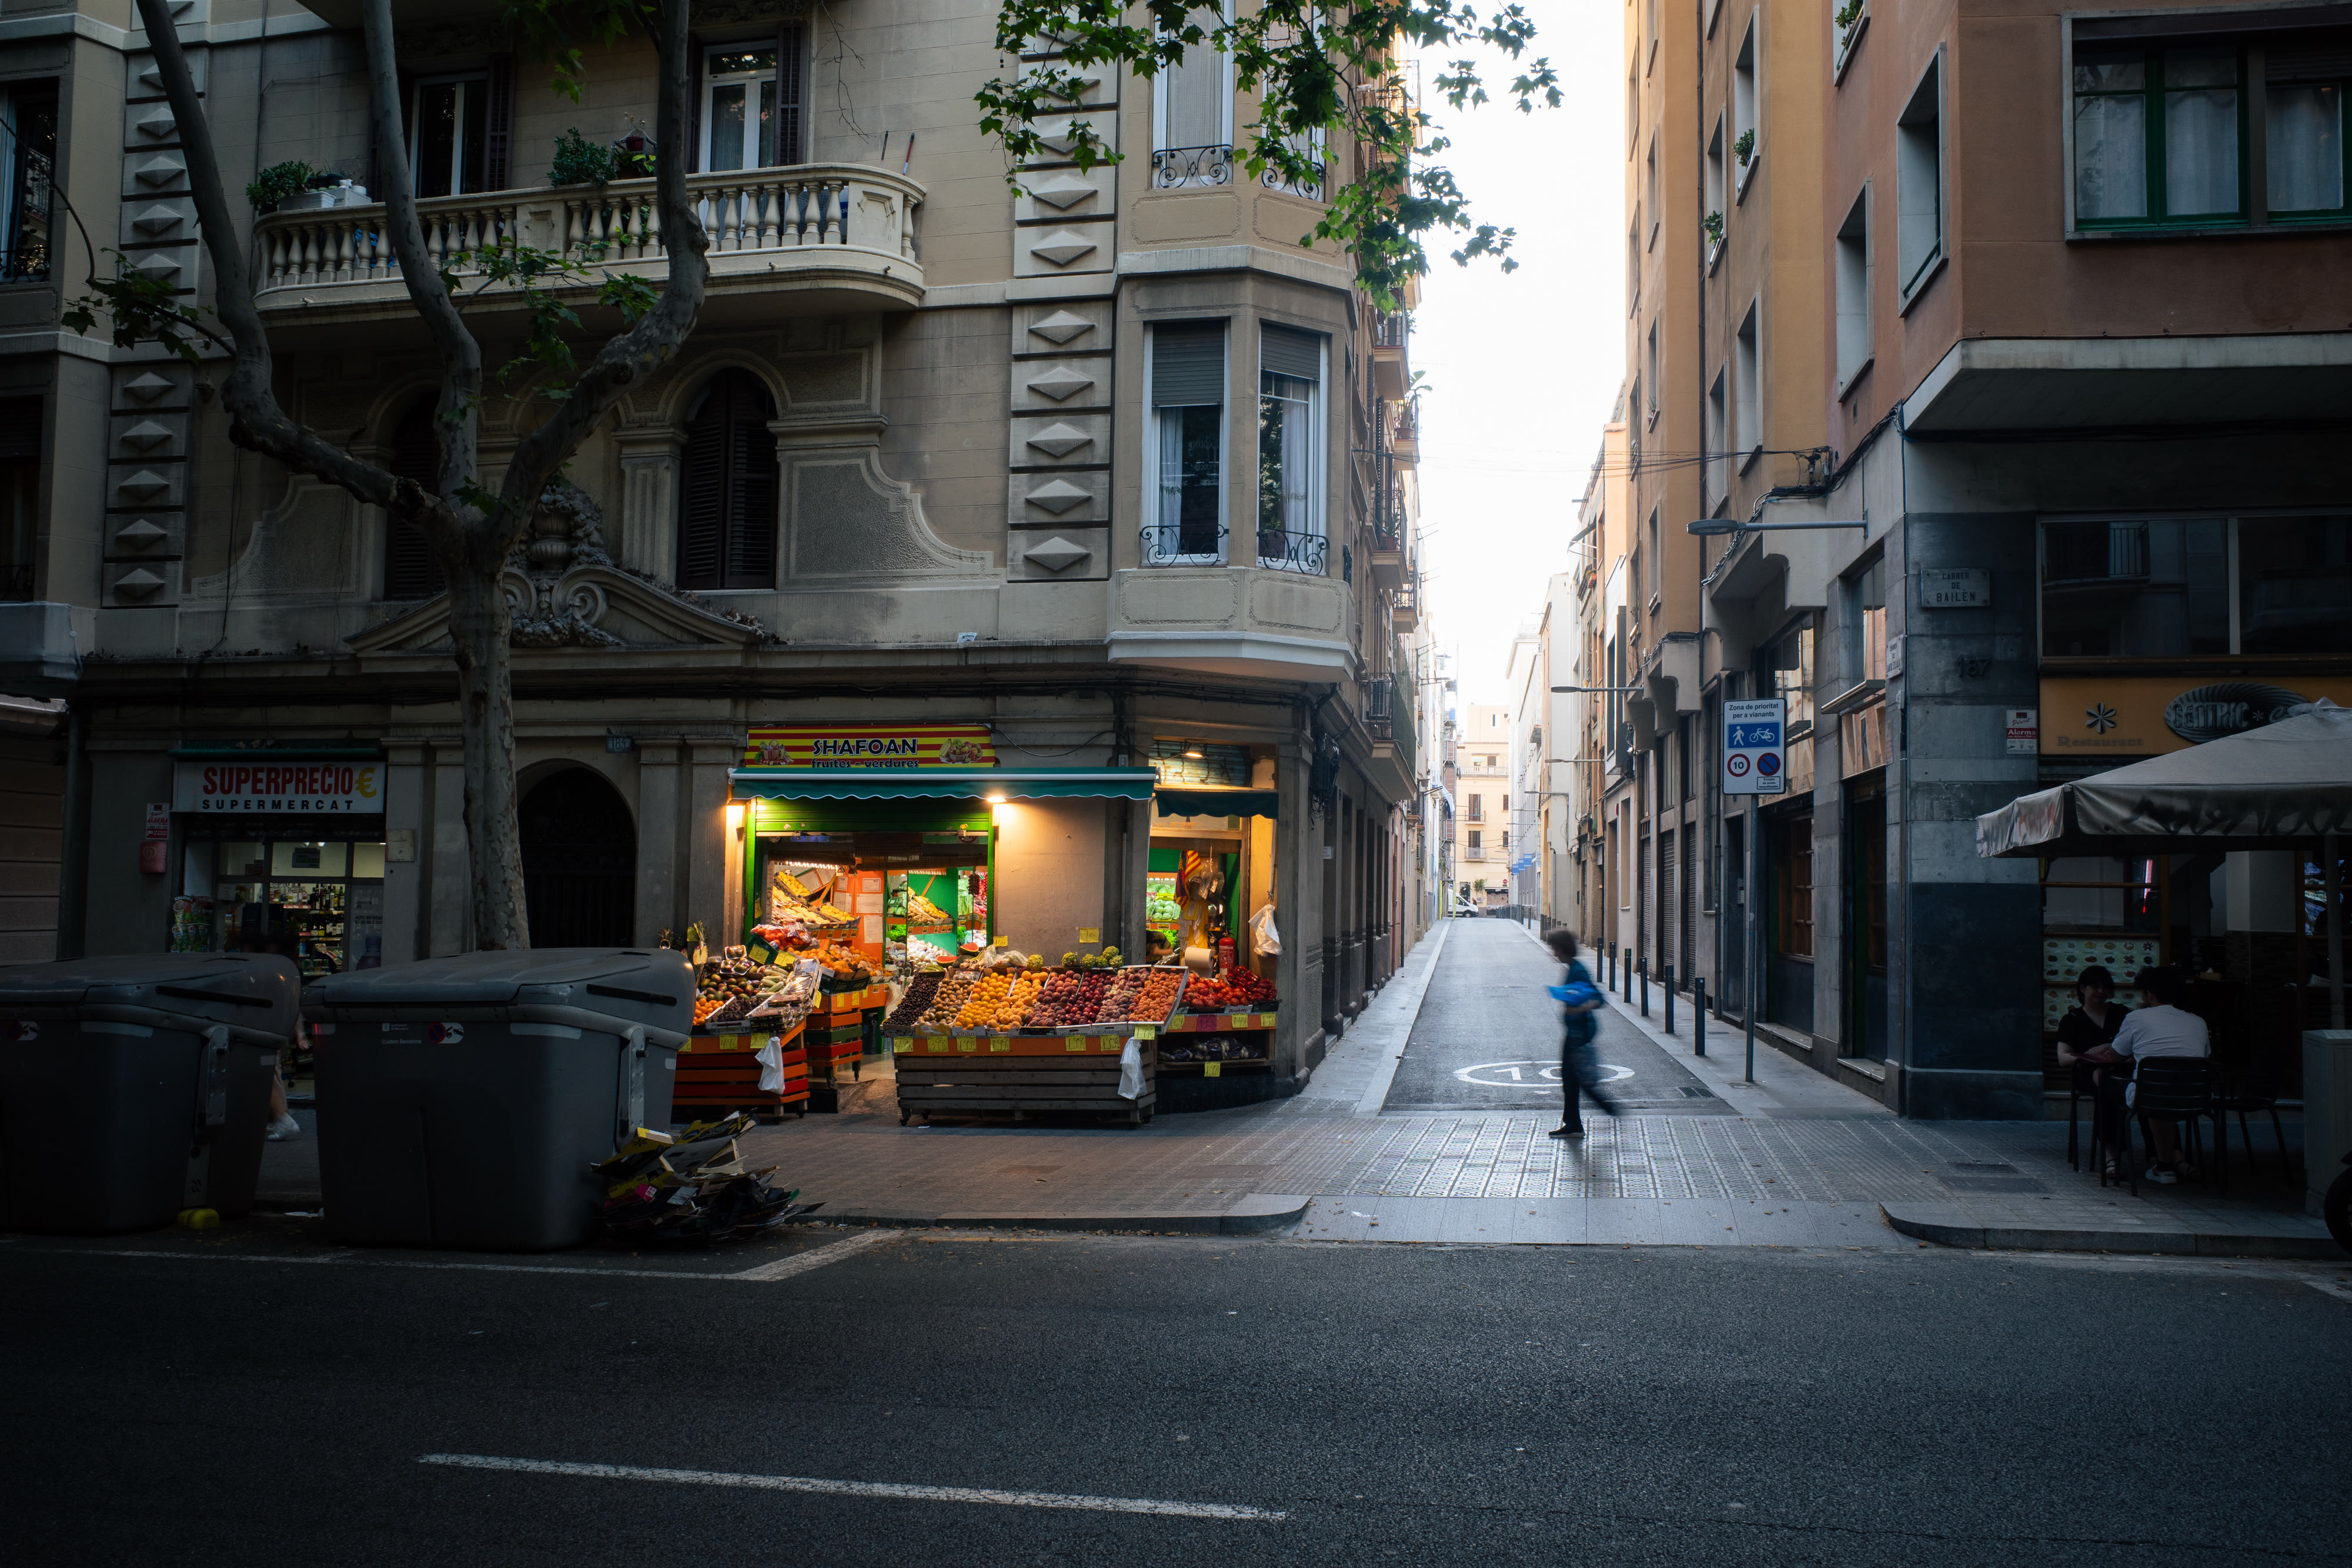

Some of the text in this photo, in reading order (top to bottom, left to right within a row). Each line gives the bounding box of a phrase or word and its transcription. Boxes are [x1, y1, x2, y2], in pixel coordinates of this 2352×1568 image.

[1956, 656, 1991, 678] 187
[1755, 703, 1779, 711] prioritat
[812, 738, 918, 756] SHAFOAN
[2057, 735, 2143, 748] Restaurant
[811, 758, 851, 768] fruites
[864, 757, 919, 768] verdures
[203, 766, 353, 795] SUPERPRECIO
[202, 799, 353, 810] SUPERMERCAT
